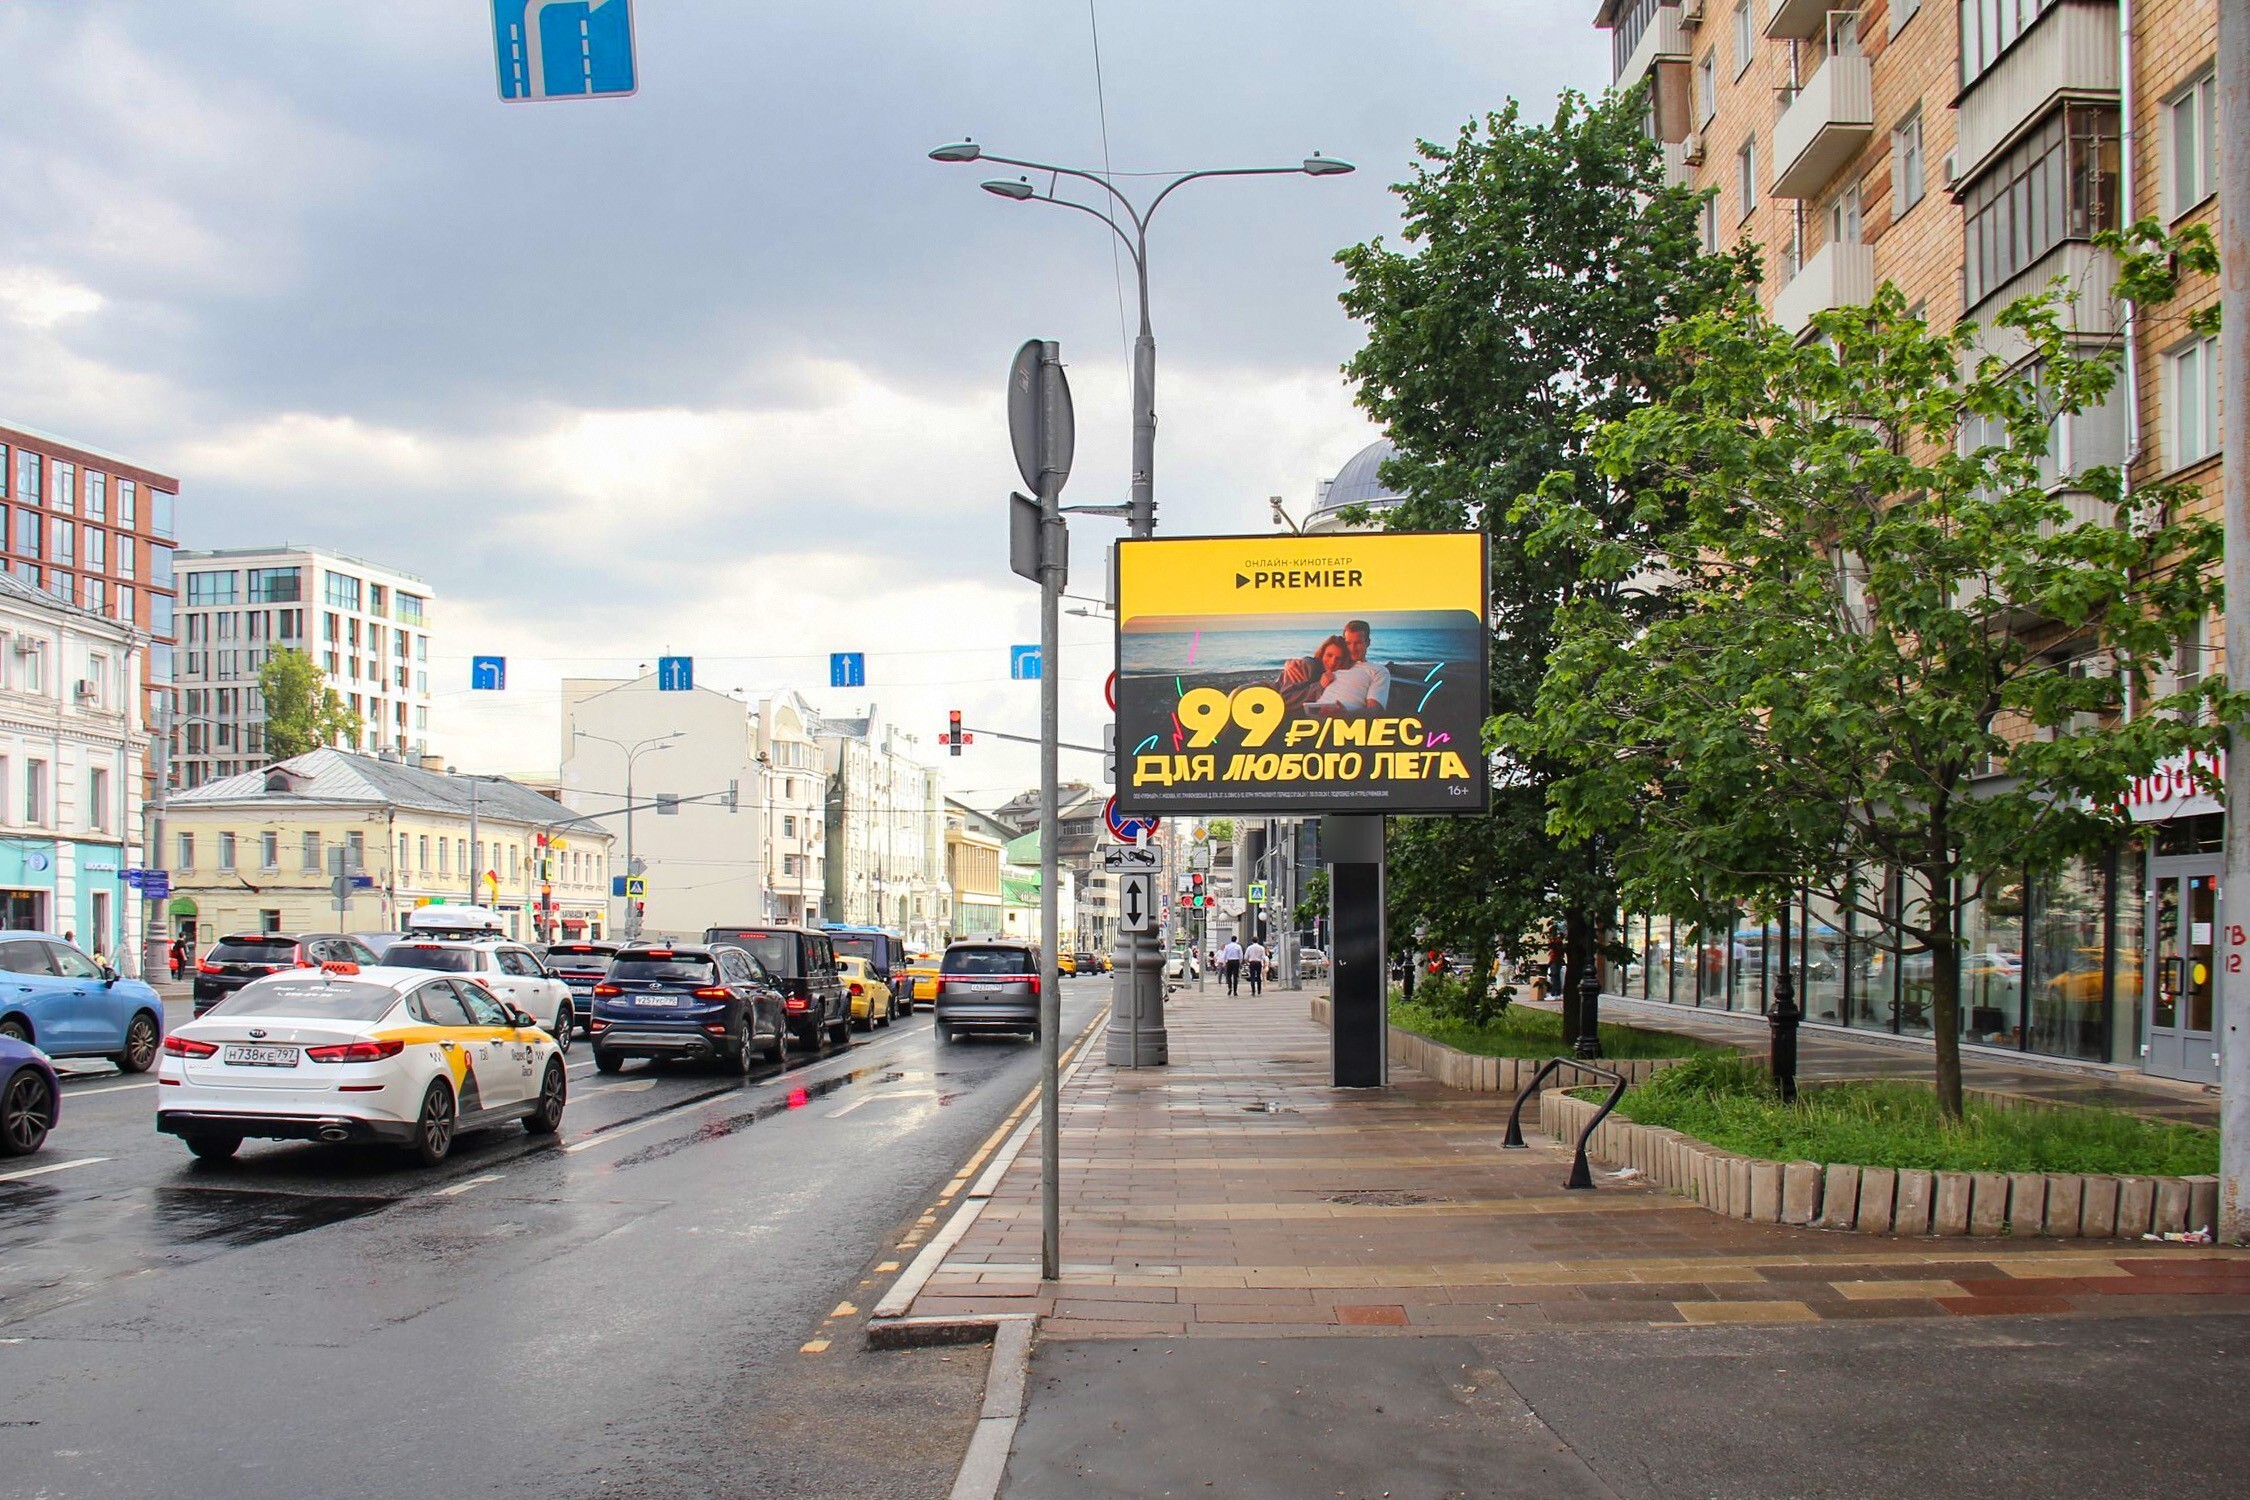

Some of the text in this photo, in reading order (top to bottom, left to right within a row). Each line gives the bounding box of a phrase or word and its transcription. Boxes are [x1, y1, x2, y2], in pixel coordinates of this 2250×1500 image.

[1245, 558, 1353, 568] ОНЛАЙН-КИНОТЕАТР
[1254, 570, 1363, 589] PREMIER
[1177, 686, 1285, 748] 99
[1133, 751, 1470, 787] ДЛЯ ЛЮБОГО ЛЕТА
[1447, 785, 1469, 796] 16+
